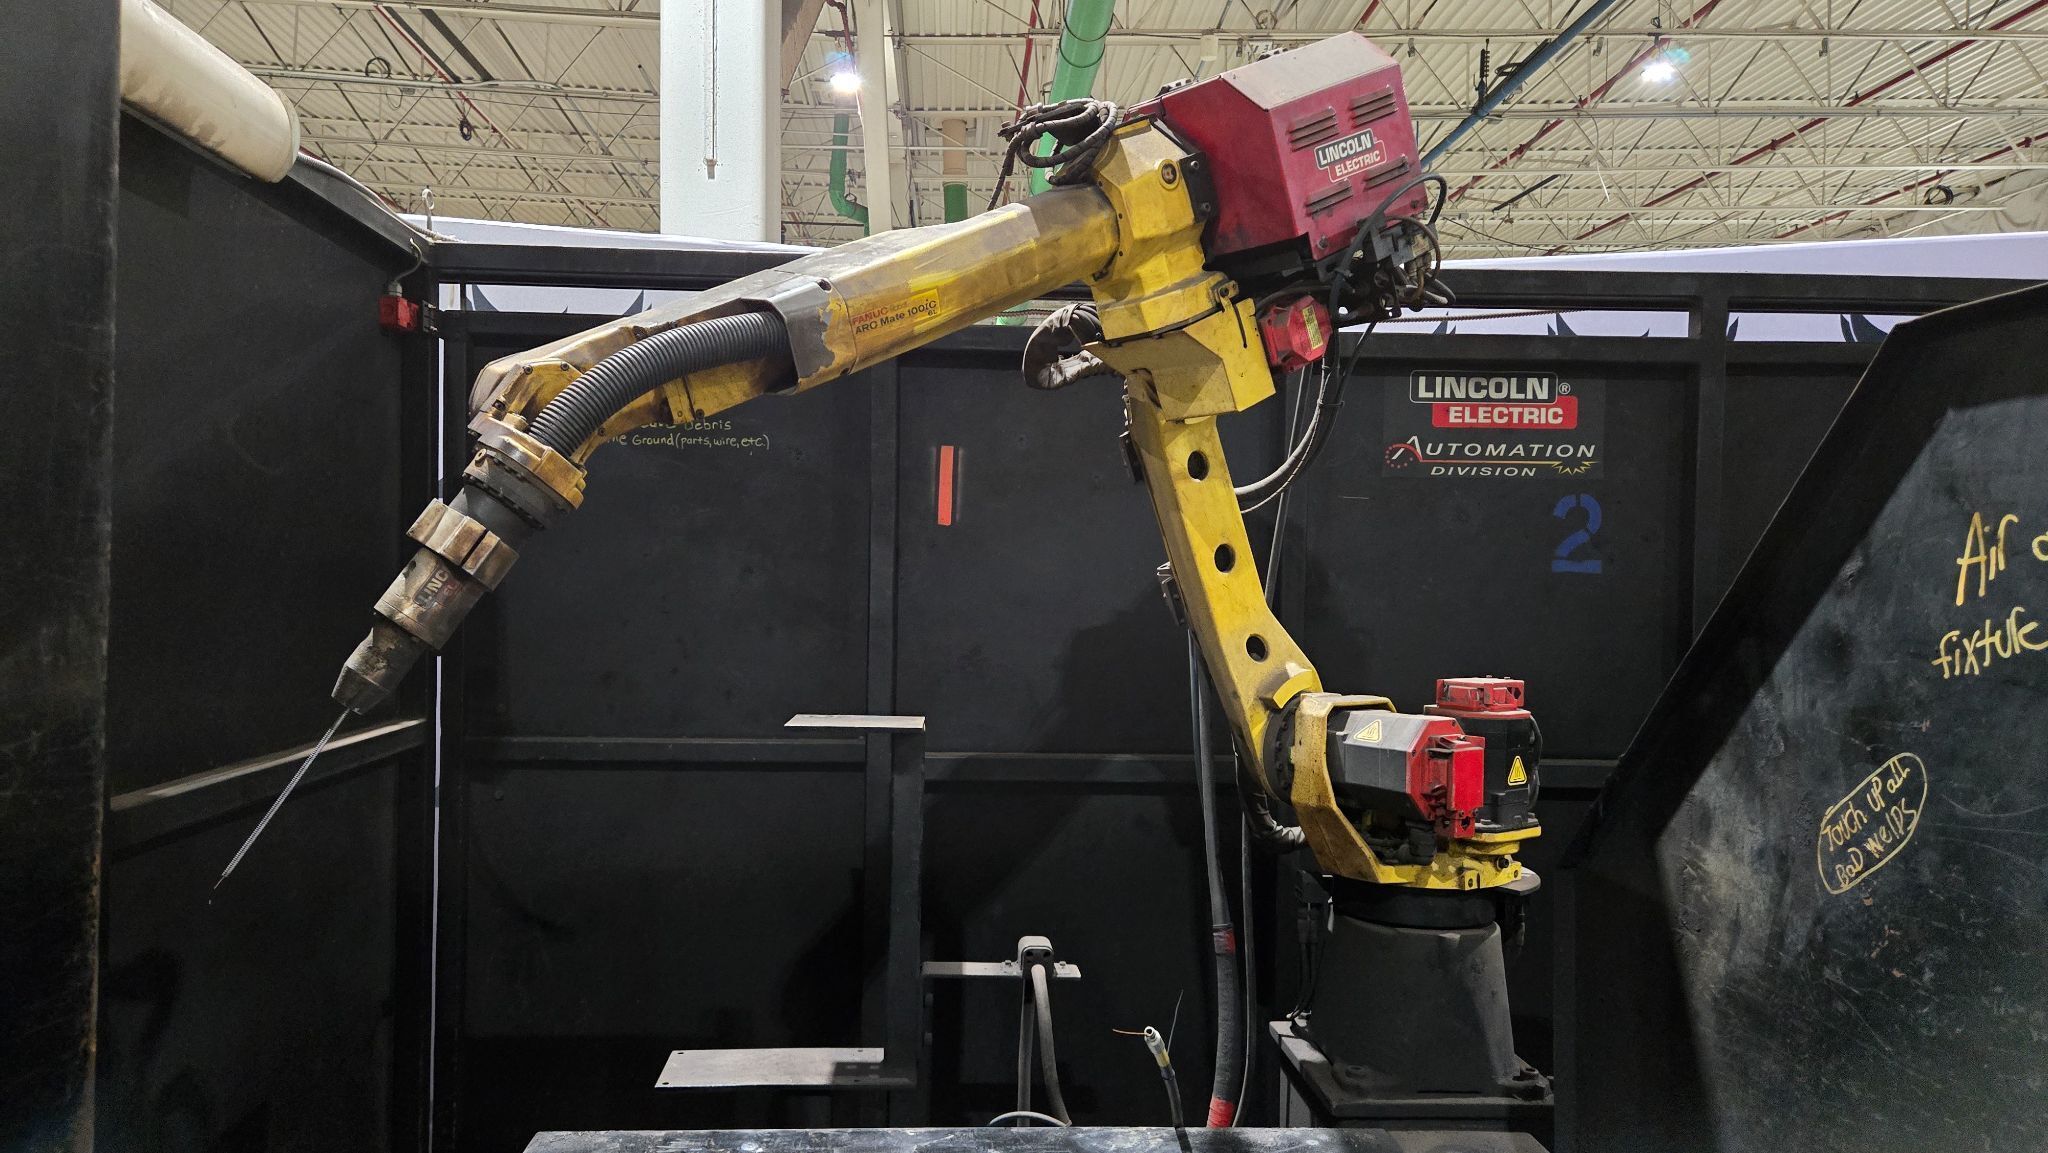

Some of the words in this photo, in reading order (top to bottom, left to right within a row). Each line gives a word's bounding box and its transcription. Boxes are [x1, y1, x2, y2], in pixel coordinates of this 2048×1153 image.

[1318, 133, 1372, 165] LINCOLN
[1335, 150, 1381, 176] ELECTRIC
[853, 306, 889, 325] FANUC
[855, 321, 878, 335] ARC
[880, 312, 905, 327] Mate
[1418, 375, 1549, 400] LINCOLN
[1449, 406, 1563, 425] ELECTRIC
[1392, 435, 1596, 460] AUTOMATION
[1431, 466, 1537, 477] DIVISION
[1551, 493, 1602, 574] 2
[1955, 511, 2020, 607] Air
[1931, 606, 2048, 680] fixture
